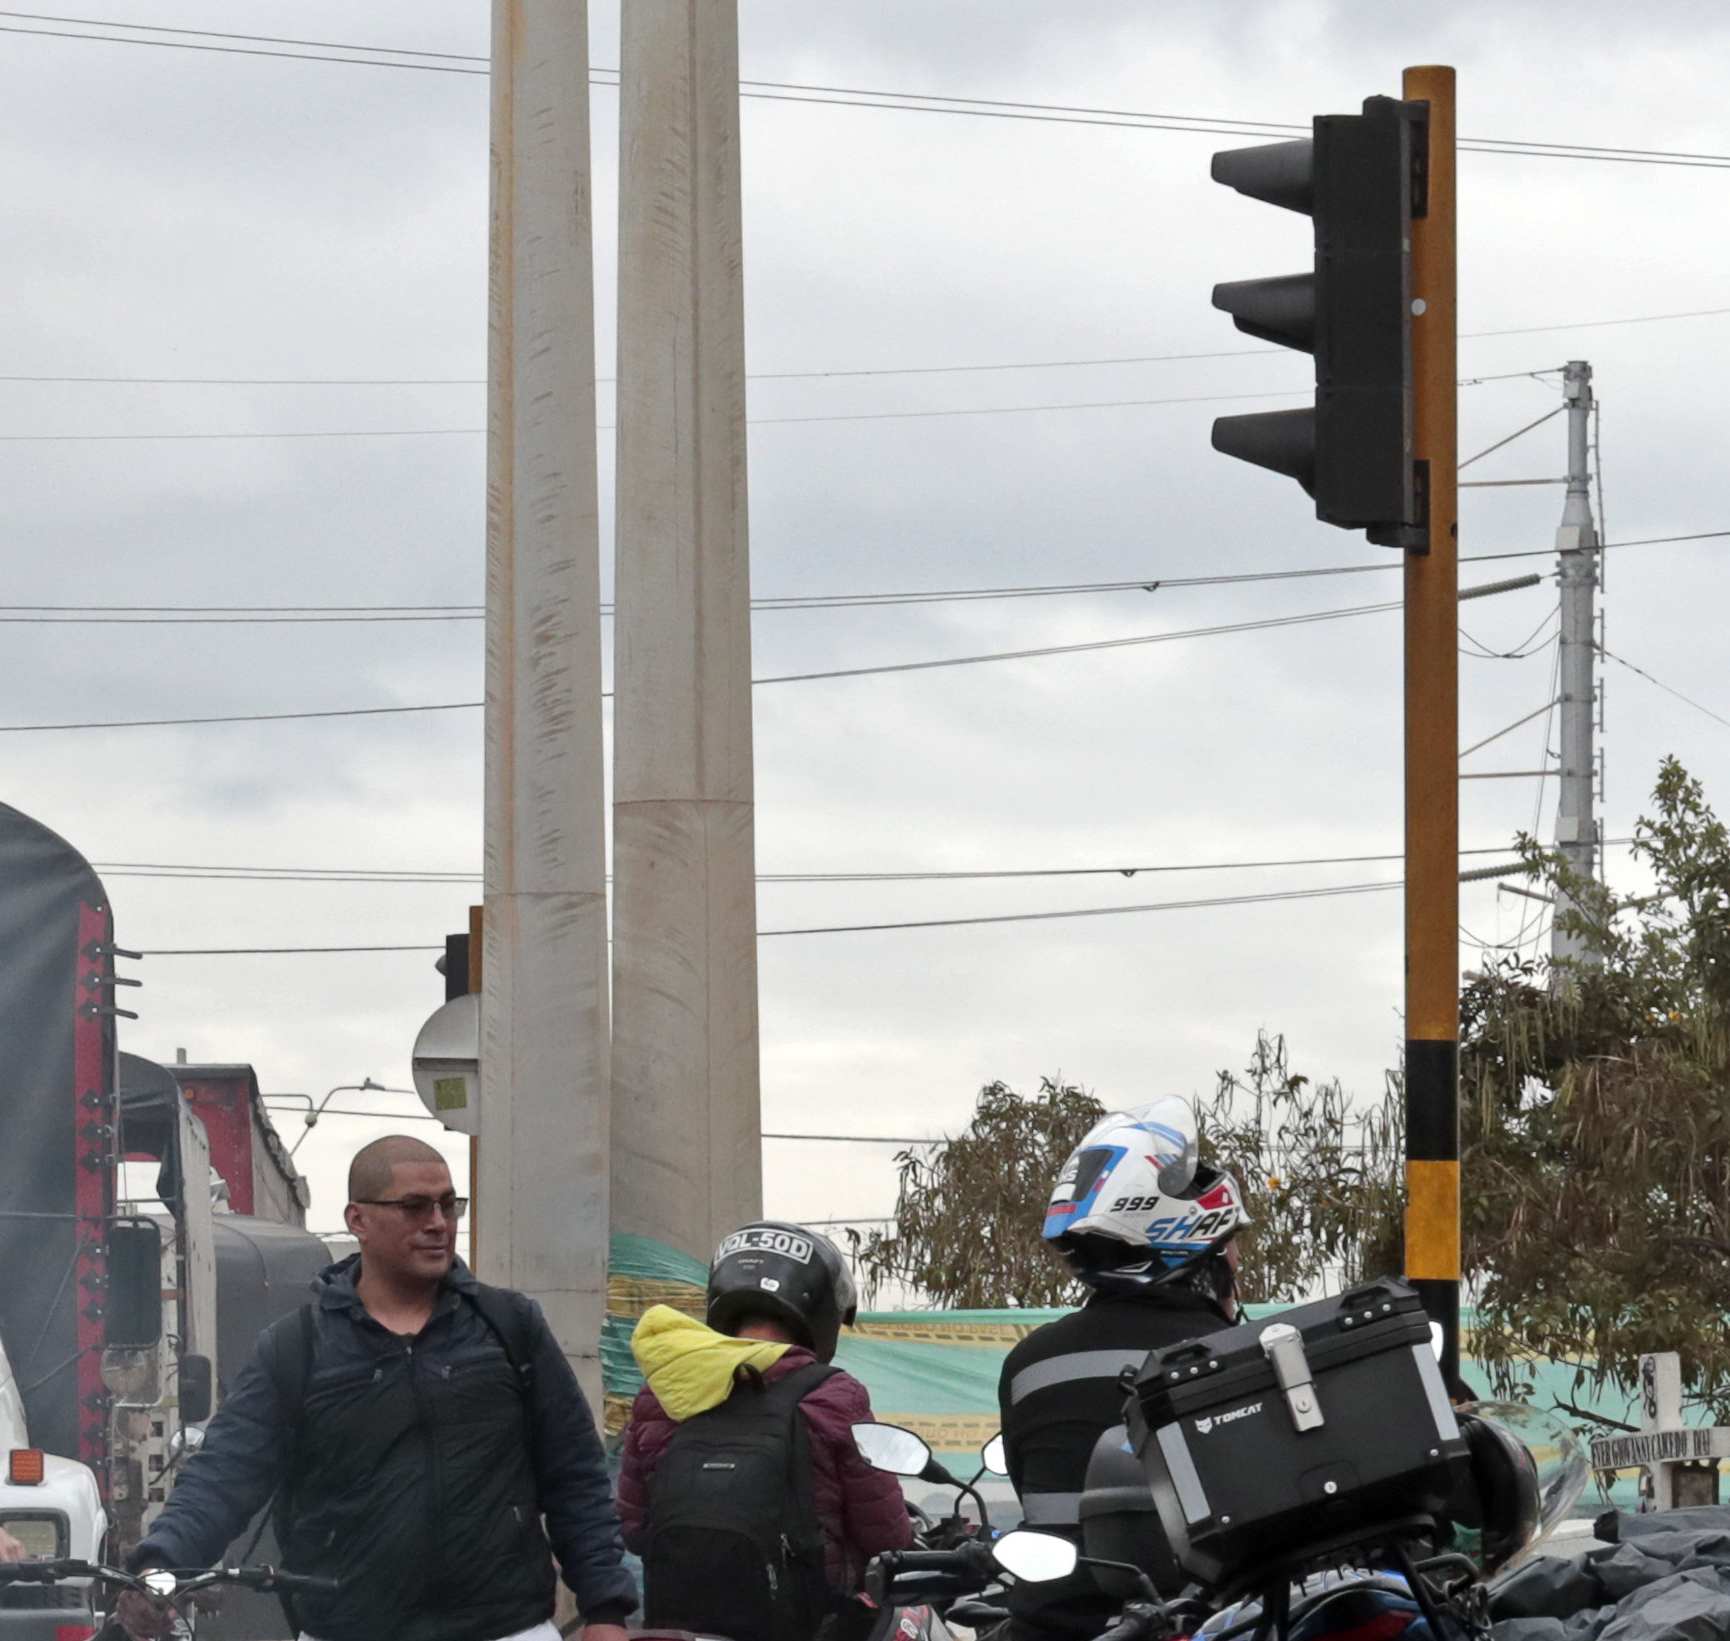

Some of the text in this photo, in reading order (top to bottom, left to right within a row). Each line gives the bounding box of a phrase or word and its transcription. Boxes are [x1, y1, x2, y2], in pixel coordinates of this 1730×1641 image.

[1110, 1196, 1160, 1212] 999
[1145, 1206, 1240, 1242] SHAF
[718, 1232, 808, 1258] VQL-50D
[1213, 1402, 1263, 1426] TOMCAT
